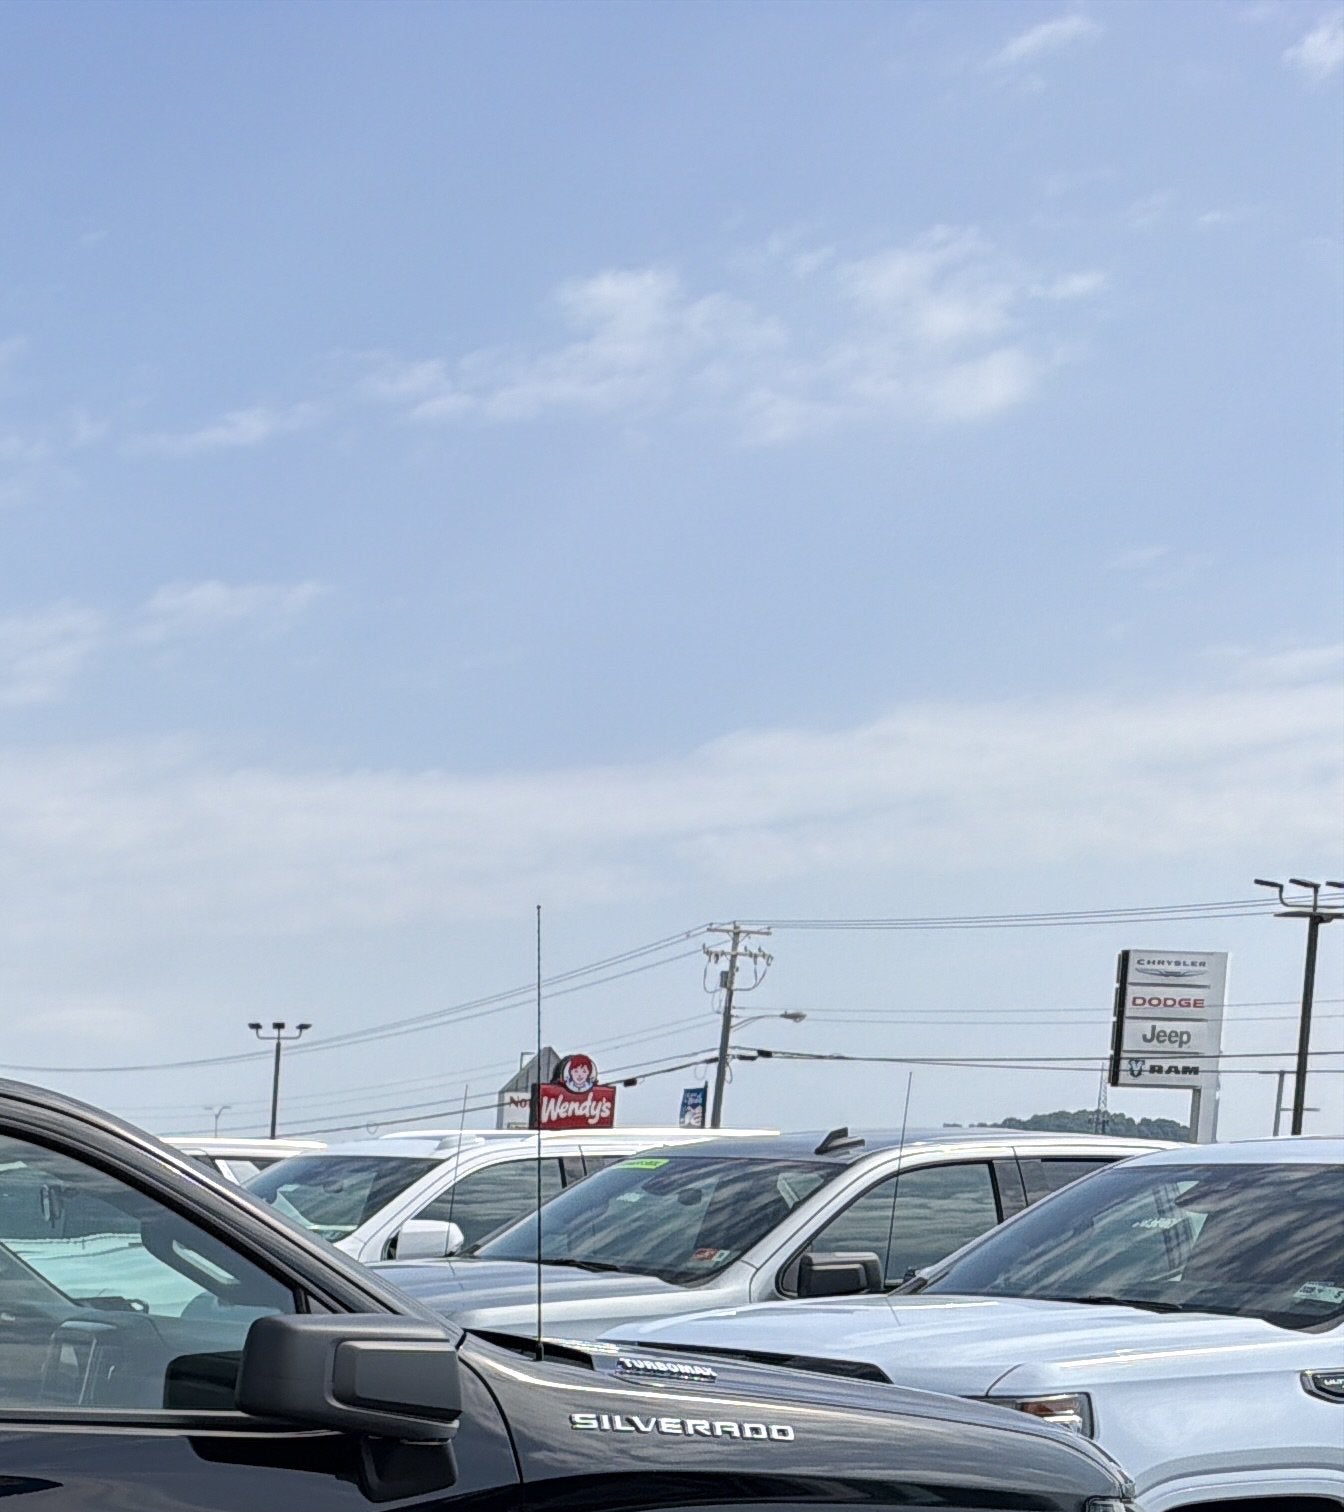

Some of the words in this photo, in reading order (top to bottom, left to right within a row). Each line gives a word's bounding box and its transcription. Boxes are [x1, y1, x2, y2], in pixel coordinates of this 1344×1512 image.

[1136, 958, 1207, 967] CHRYSLER
[1131, 996, 1205, 1008] DODGE
[1142, 1024, 1192, 1048] Jeep
[1148, 1064, 1200, 1075] RAM
[541, 1092, 611, 1125] Wendy's
[618, 1358, 718, 1378] TURBOMAX
[569, 1413, 796, 1442] SILVERADO
